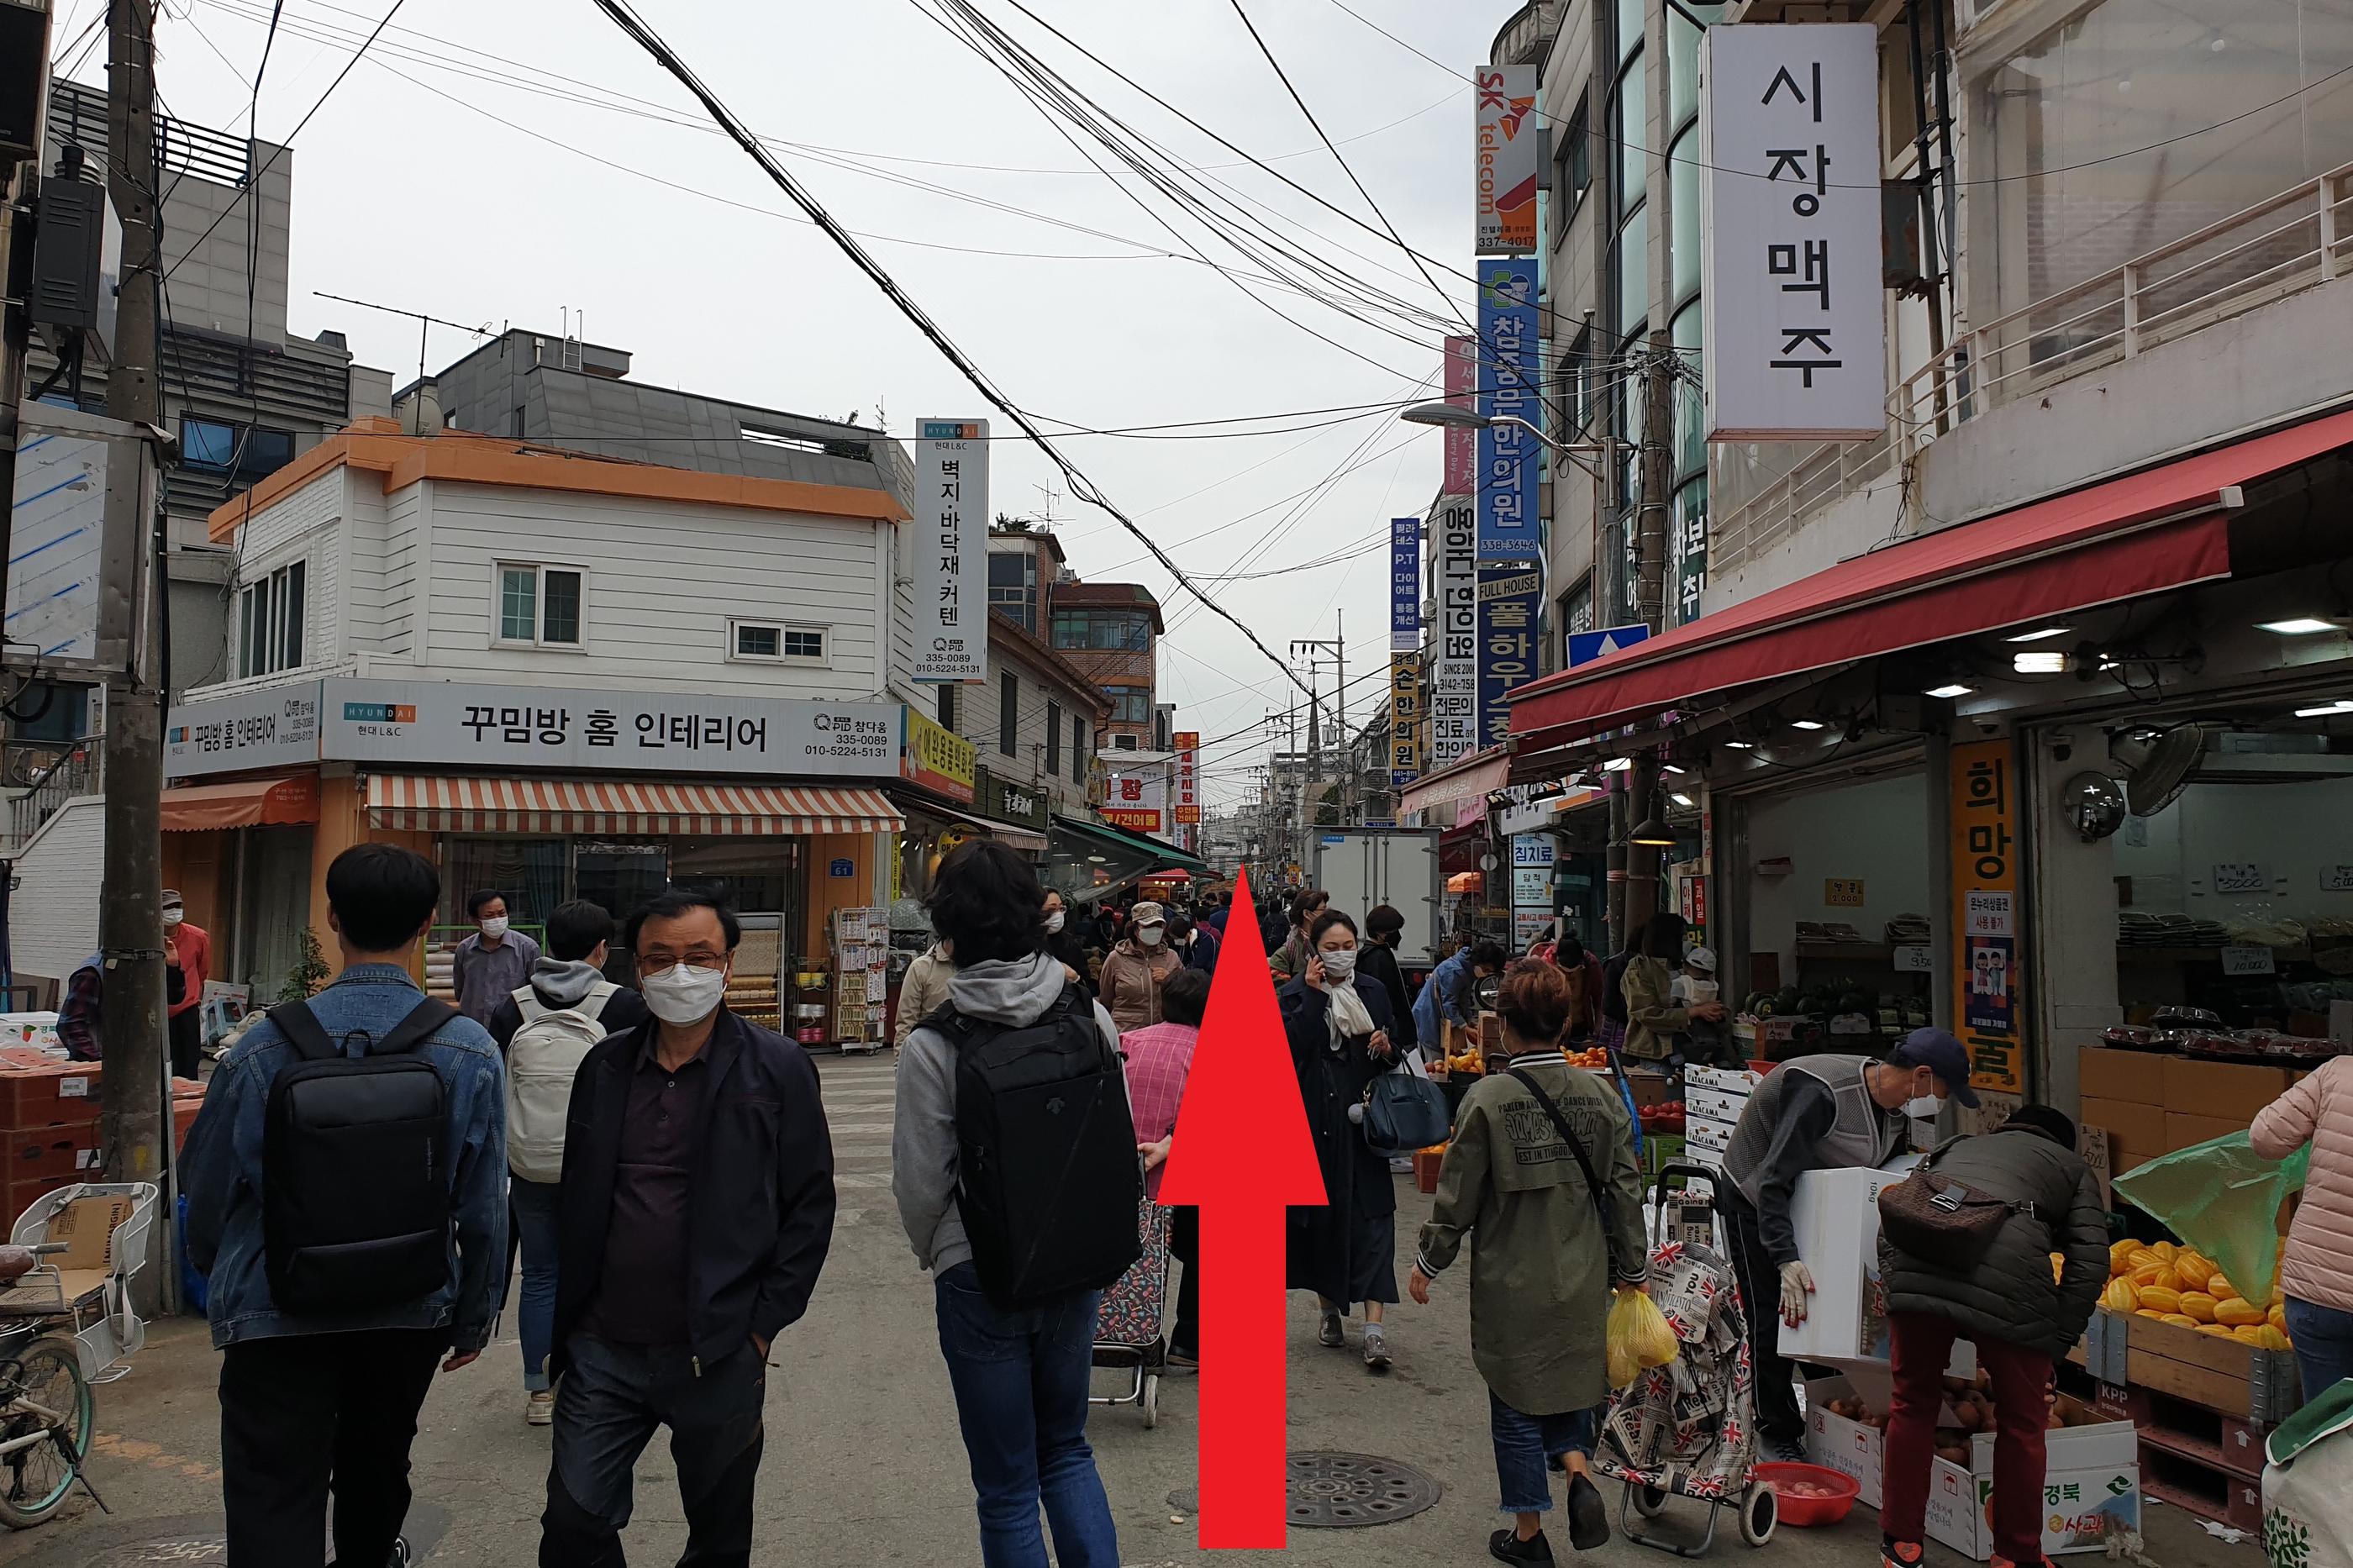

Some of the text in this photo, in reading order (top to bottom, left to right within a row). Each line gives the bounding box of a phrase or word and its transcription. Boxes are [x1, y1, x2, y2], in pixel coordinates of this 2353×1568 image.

[1479, 72, 1504, 214] SK telecom
[1761, 61, 1842, 389] 시장맥주
[1478, 236, 1534, 247] 337-4017
[928, 427, 976, 435] HYUNDAI
[934, 442, 967, 450] 현대 L&C
[1395, 523, 1416, 534] 필라
[1395, 535, 1415, 545] 테스
[1480, 539, 1536, 551] 338-3646
[1395, 553, 1415, 565] P.T
[1395, 573, 1415, 584] 다이
[1445, 508, 1475, 660] 용하다 한의원
[1395, 585, 1415, 596] 어트
[1479, 576, 1536, 599] FULL HOUSE
[1395, 602, 1415, 614] 통증
[1395, 614, 1415, 626] 개선
[925, 654, 971, 663] 335-0089
[1393, 654, 1415, 666] 경희
[916, 664, 981, 673] 010-5224-5131
[1444, 664, 1461, 676] SINCE
[349, 706, 412, 718] HYUNDAI
[1394, 668, 1414, 766] 손한의원
[358, 725, 403, 737] 현대 L&C
[461, 705, 766, 753] 꾸밈방 홈 인테리어
[855, 720, 887, 734] 참다움
[1435, 720, 1464, 739] 진료
[194, 722, 222, 754] 꾸밈방
[224, 719, 234, 750] 홈
[237, 713, 276, 748] 인테리어
[835, 734, 887, 745] 335-0089
[804, 745, 887, 758] 010-5224-5131
[1966, 758, 2012, 880] 희망
[1515, 846, 1553, 862] 침치료
[1695, 885, 1704, 918] 과일
[1970, 897, 2009, 912] 온누리상품권
[1976, 917, 1988, 929] 사용
[1691, 1076, 1719, 1087] ATACAMA
[1692, 1105, 1719, 1117] ATACAMA
[1691, 1134, 1719, 1147] ATACAMA
[1868, 1181, 1877, 1202] 10kg
[1684, 1272, 1699, 1295] YOU
[2102, 1384, 2129, 1403] KPP
[2045, 1482, 2081, 1507] 경북
[2064, 1513, 2104, 1534] 사과
